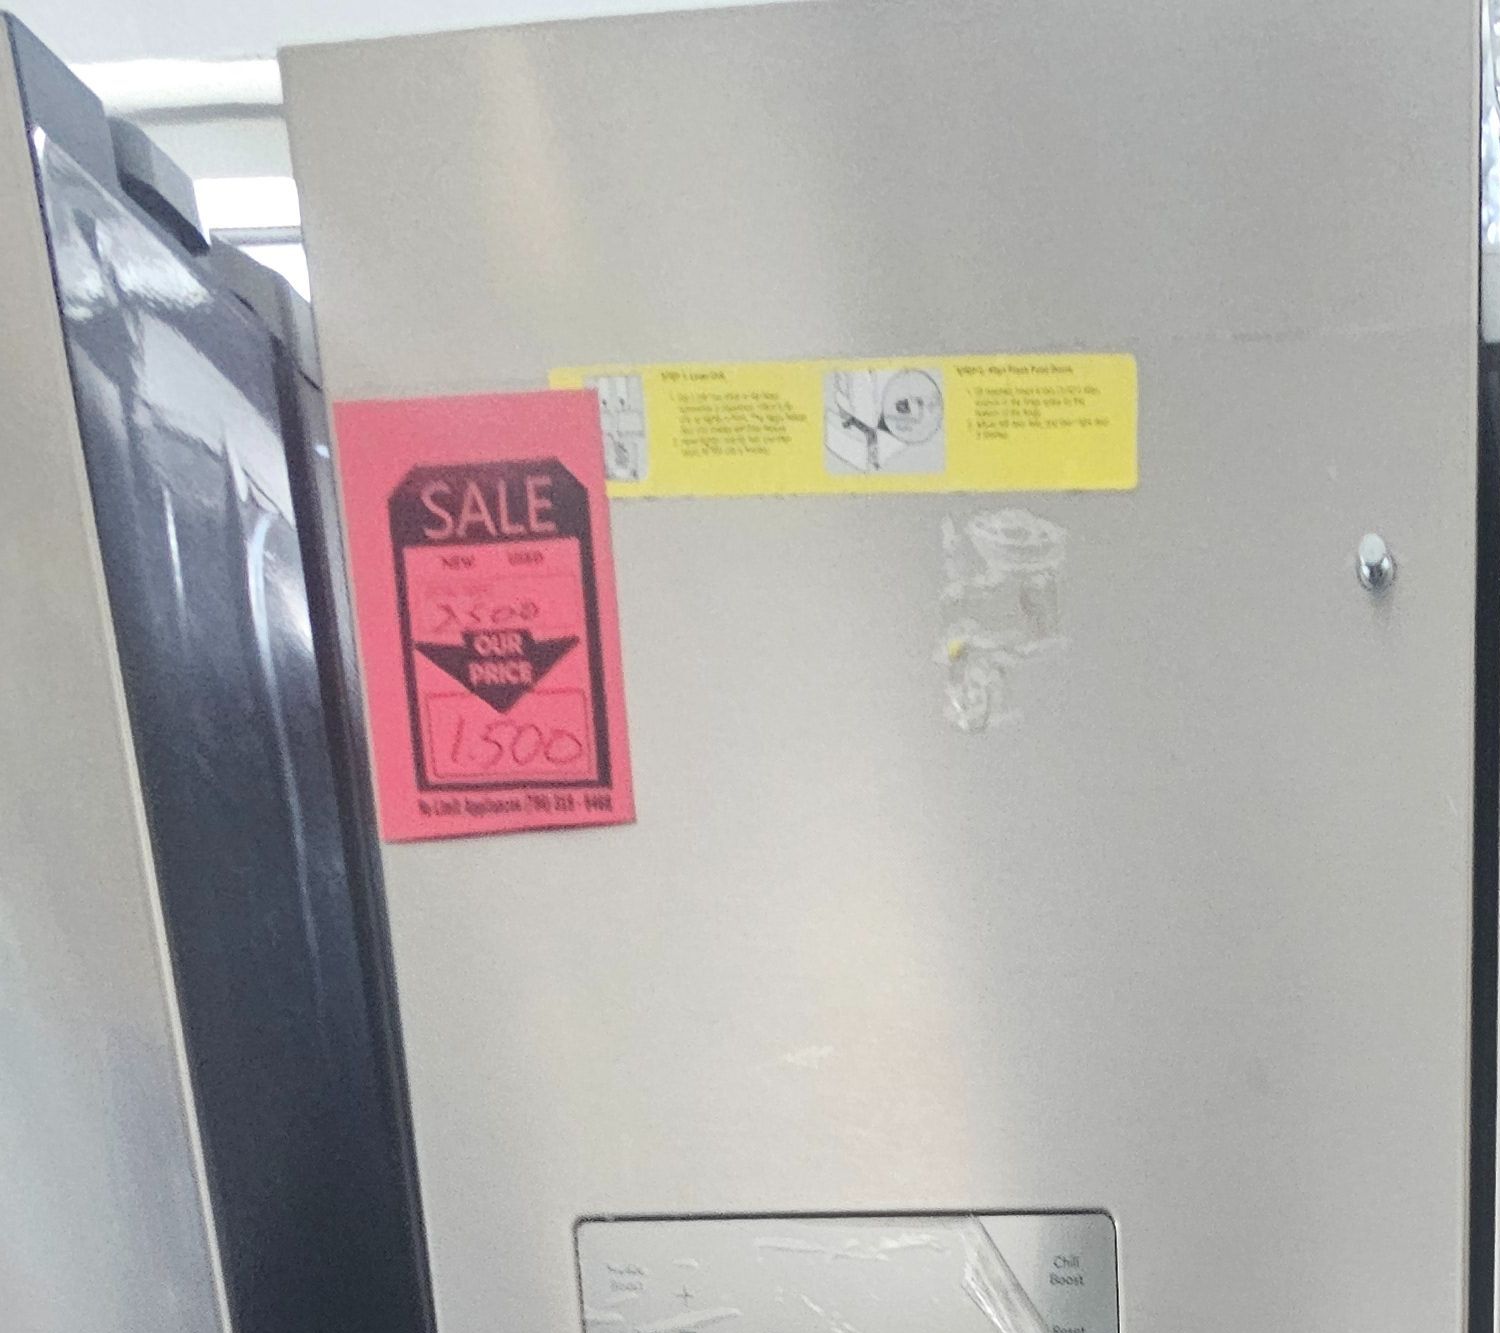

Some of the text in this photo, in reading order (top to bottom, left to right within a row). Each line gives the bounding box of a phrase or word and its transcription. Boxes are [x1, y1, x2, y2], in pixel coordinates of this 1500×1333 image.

[421, 474, 559, 540] SALE
[441, 554, 477, 570] NEW
[473, 633, 524, 657] OUR
[468, 660, 534, 685] PRICE
[451, 716, 582, 767] 1500
[1053, 1256, 1080, 1269] Chill
[1050, 1275, 1084, 1287] Boost
